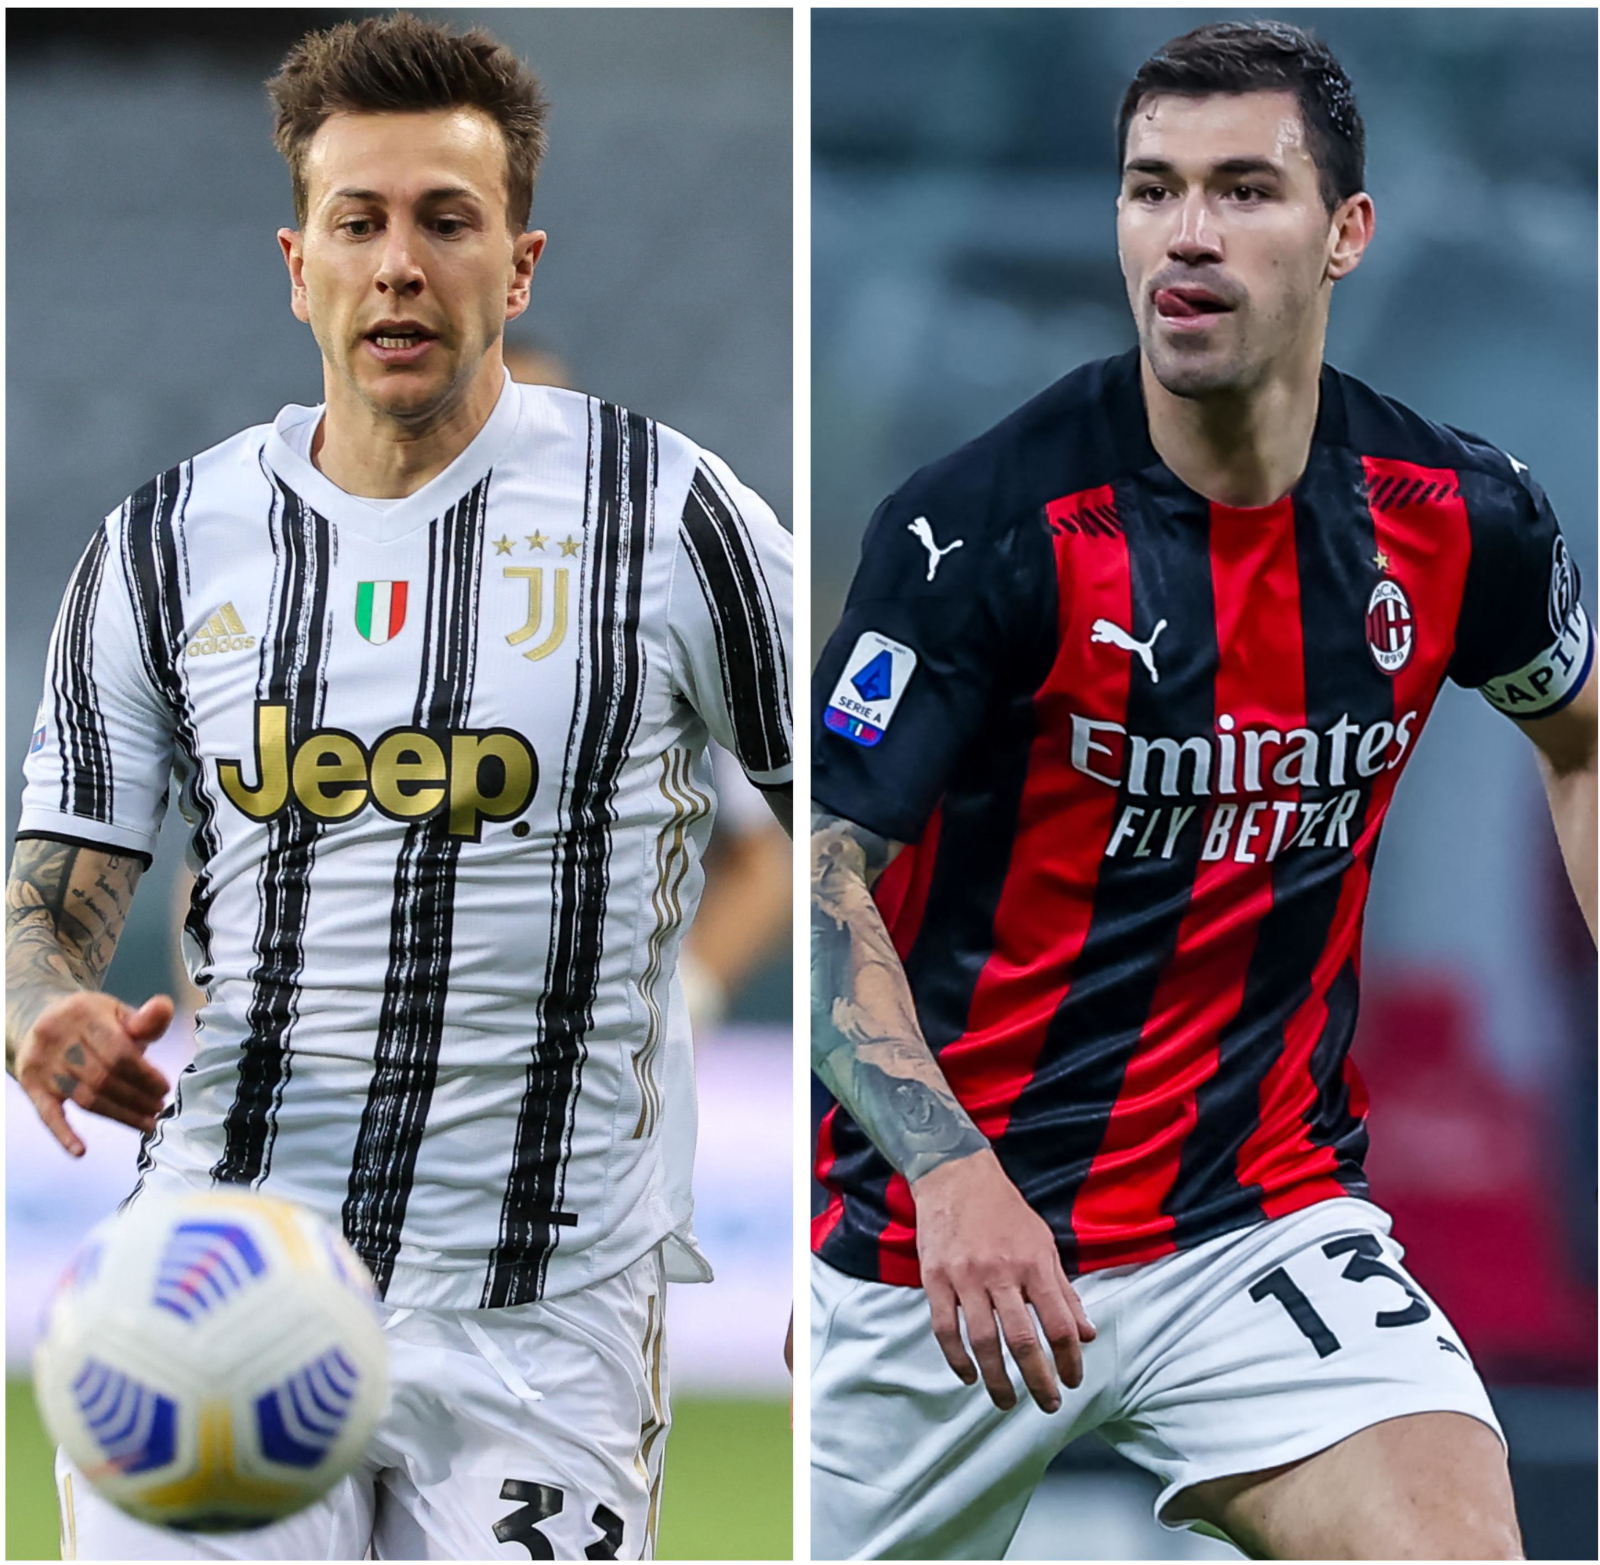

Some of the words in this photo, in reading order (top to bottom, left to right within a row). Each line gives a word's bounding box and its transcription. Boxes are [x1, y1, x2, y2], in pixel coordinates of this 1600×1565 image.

[187, 634, 256, 657] adidas
[1379, 650, 1404, 664] 1899
[838, 695, 873, 719] SERIE
[872, 712, 882, 724] A
[215, 700, 539, 843] Jeep
[1069, 710, 1417, 797] Emirates
[1104, 804, 1197, 860] FLY
[1200, 789, 1361, 864] BETTER
[1247, 1233, 1432, 1360] 13
